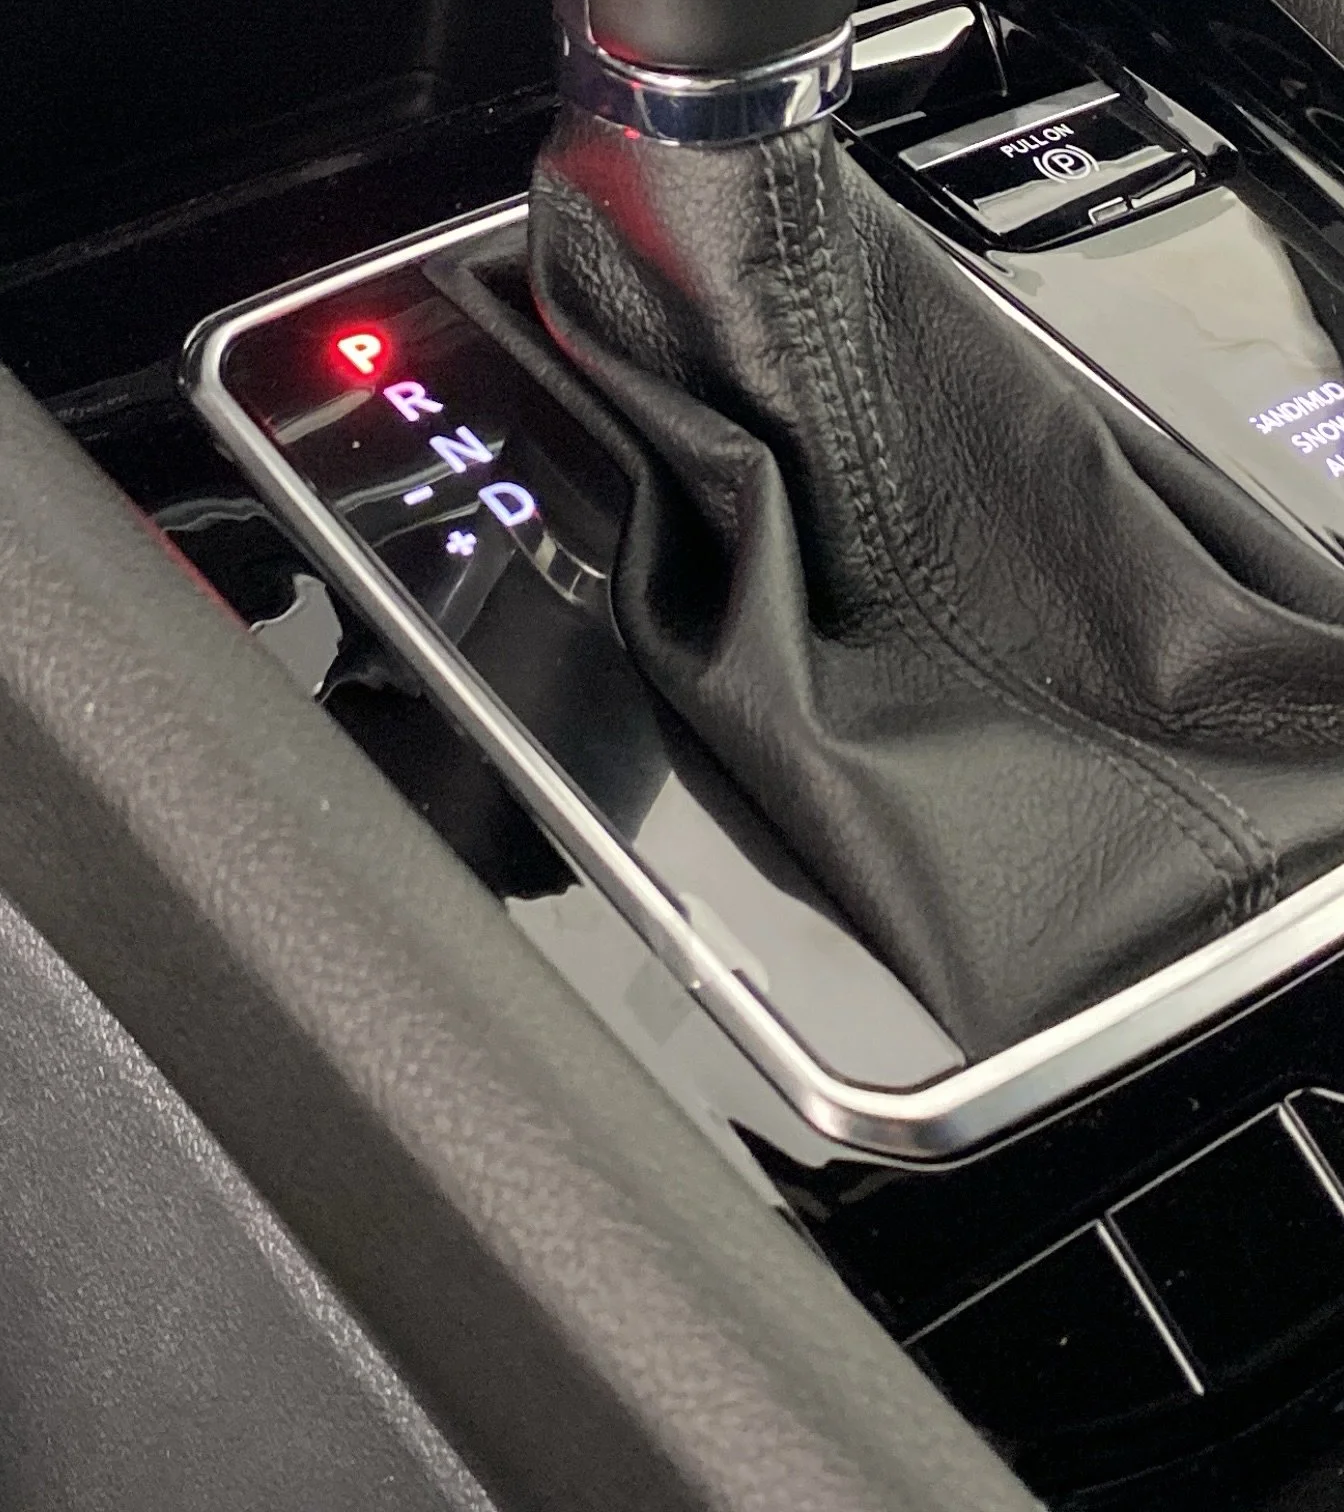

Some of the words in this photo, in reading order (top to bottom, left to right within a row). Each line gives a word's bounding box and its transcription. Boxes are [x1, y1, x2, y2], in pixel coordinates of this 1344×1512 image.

[1000, 135, 1049, 158] PULL
[1042, 123, 1075, 141] ON
[337, 334, 381, 374] P
[383, 381, 444, 421] R
[429, 425, 494, 473] N
[478, 482, 535, 527] D
